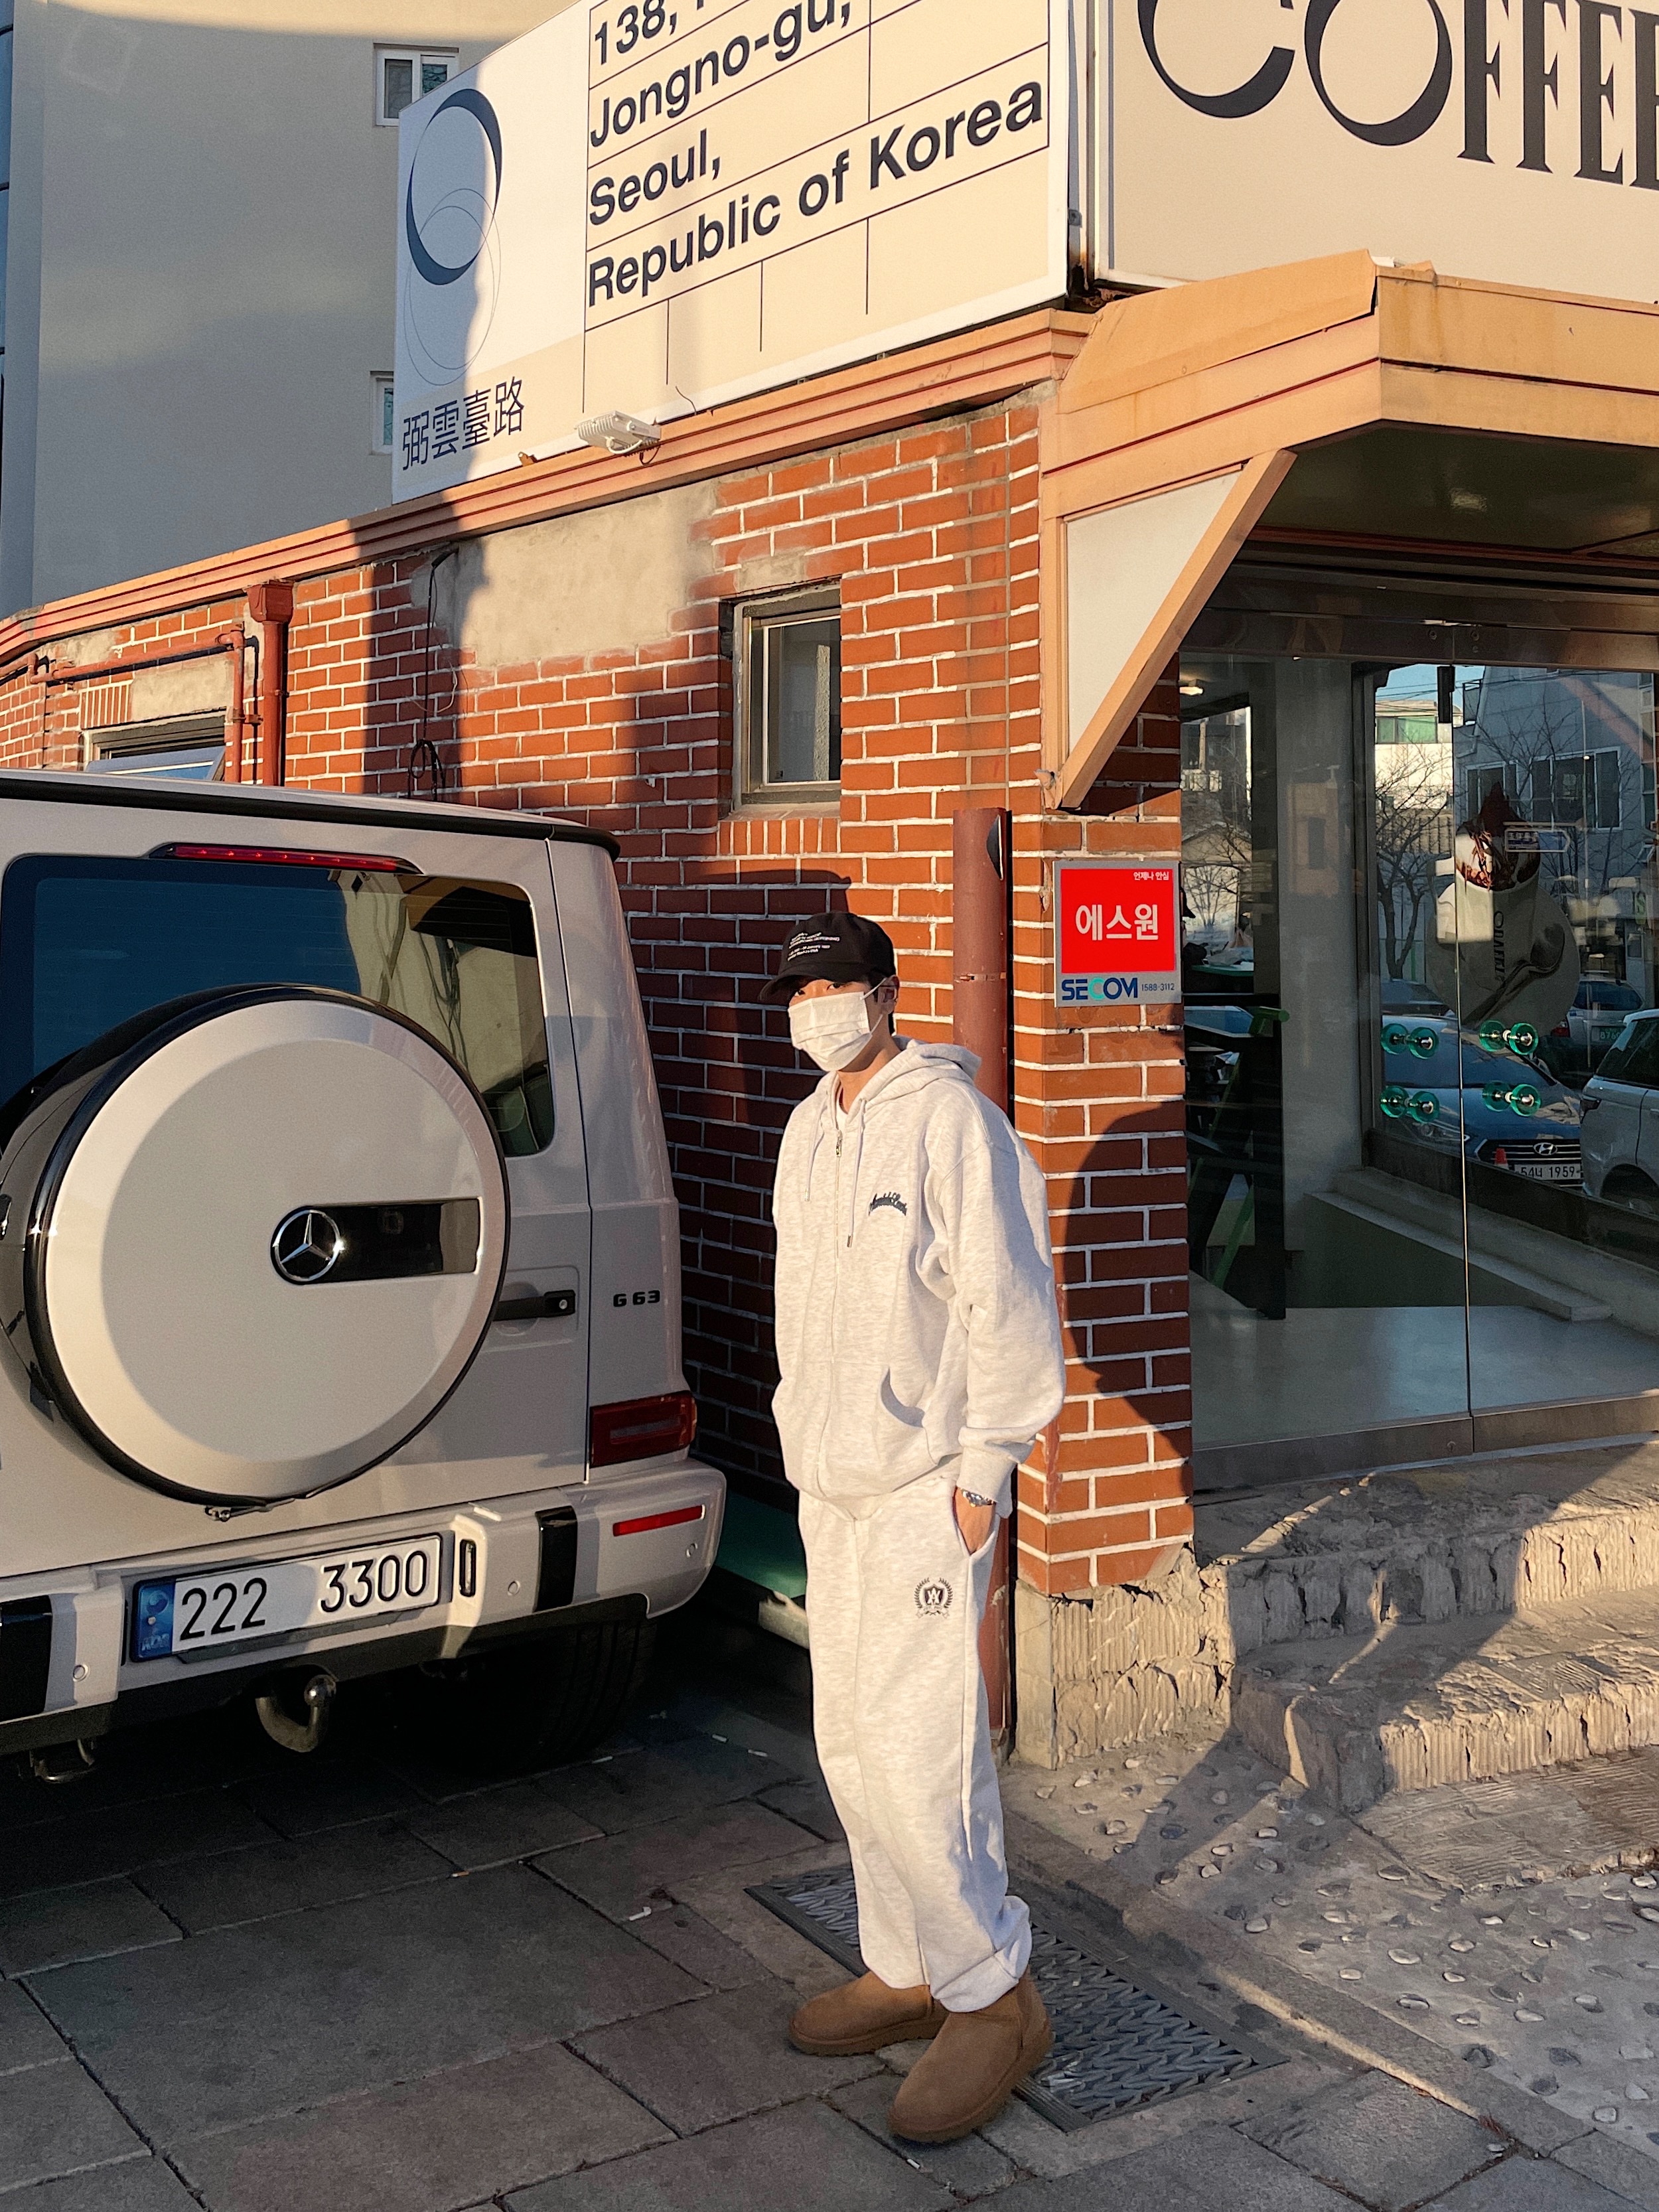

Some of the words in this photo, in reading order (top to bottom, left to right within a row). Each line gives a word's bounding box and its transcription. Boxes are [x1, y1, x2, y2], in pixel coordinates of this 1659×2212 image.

[594, 0, 678, 65] 138,
[590, 0, 850, 147] Jongno-gu,
[589, 127, 721, 226] Seoul,
[589, 194, 781, 308] Republic
[798, 149, 849, 216] of
[870, 81, 1043, 190] Korea
[1133, 871, 1154, 881] 언제나
[1155, 871, 1169, 881] 안심
[1075, 903, 1159, 941] 에스원
[1062, 977, 1138, 1001] SECOM
[179, 1577, 268, 1641] 222
[320, 1550, 428, 1613] 3300
